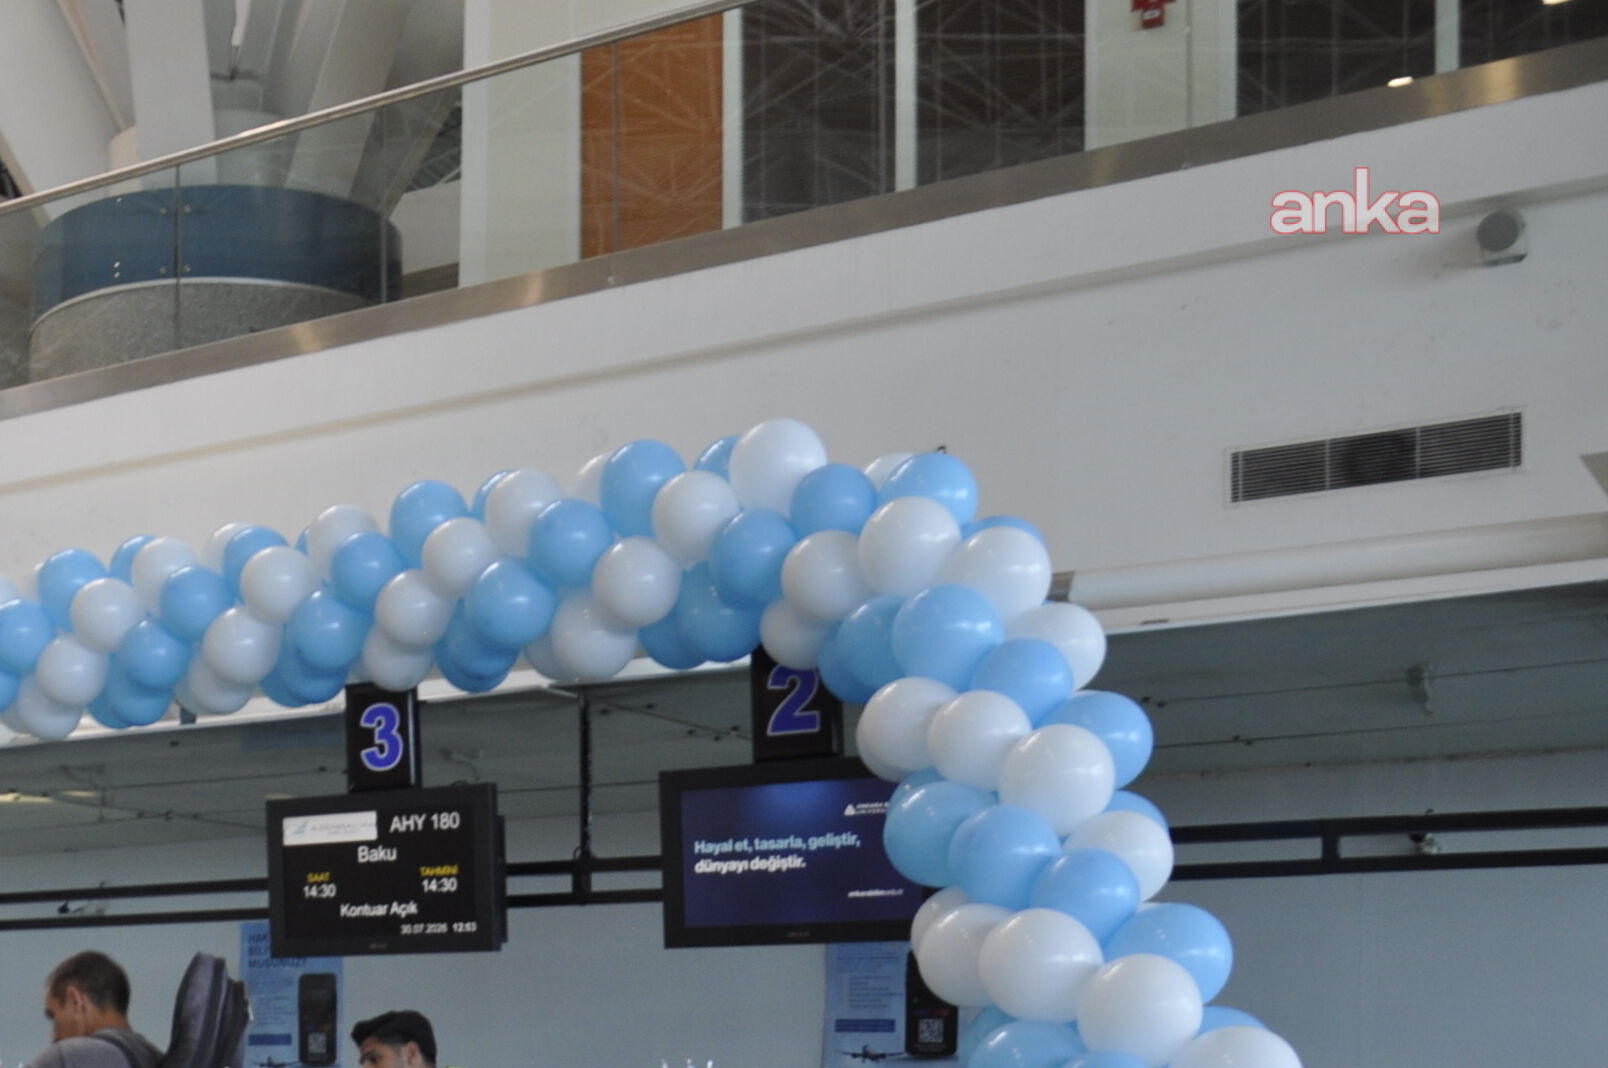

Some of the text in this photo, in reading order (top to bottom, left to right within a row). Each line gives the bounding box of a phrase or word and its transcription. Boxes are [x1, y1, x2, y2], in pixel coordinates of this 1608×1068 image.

[766, 664, 821, 736] 2
[360, 702, 404, 771] 3
[390, 814, 426, 832] AHY
[431, 812, 459, 829] 180
[695, 831, 860, 854] Hayal et, tasarla, geliştir,
[358, 845, 397, 862] Baku
[695, 854, 806, 873] dünyayı değiştir.
[304, 877, 457, 897] 14:30 14:30
[307, 872, 330, 882] SAAT
[341, 903, 387, 916] Kontuar
